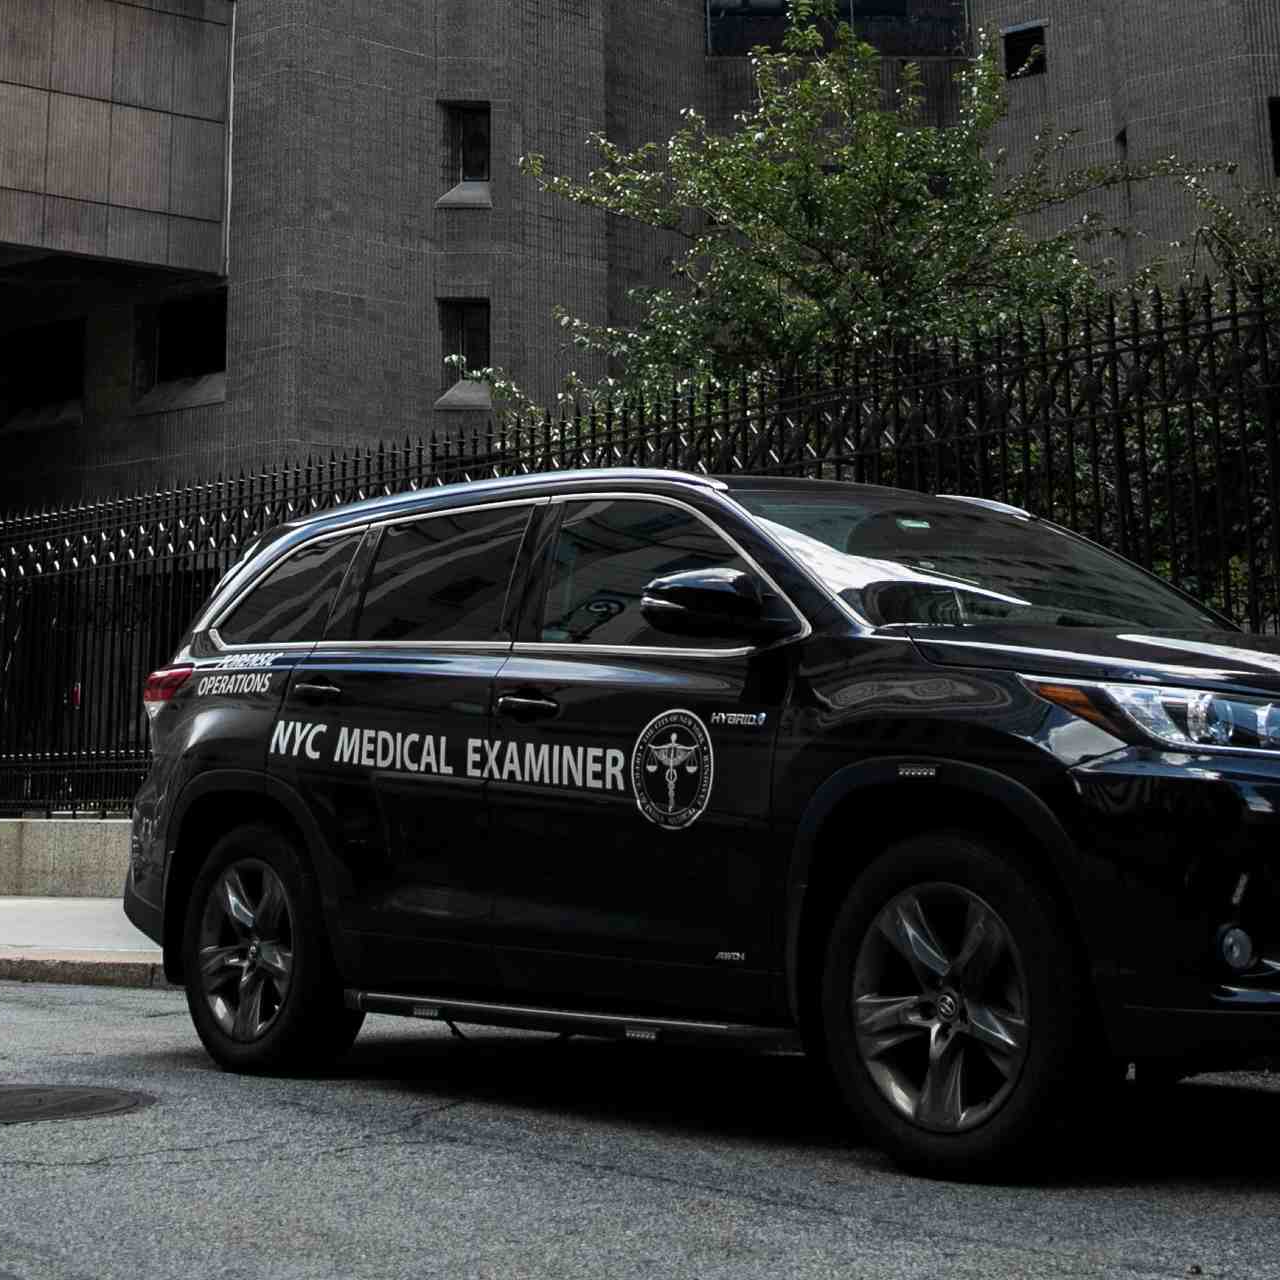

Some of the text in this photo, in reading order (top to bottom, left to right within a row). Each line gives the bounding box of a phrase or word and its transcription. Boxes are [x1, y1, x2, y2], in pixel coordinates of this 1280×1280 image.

[197, 673, 272, 696] OPERATIONS
[711, 712, 756, 725] HYBRID
[270, 720, 327, 759] NYC
[333, 726, 454, 775] MEDICAL
[466, 737, 626, 791] EXAMINER
